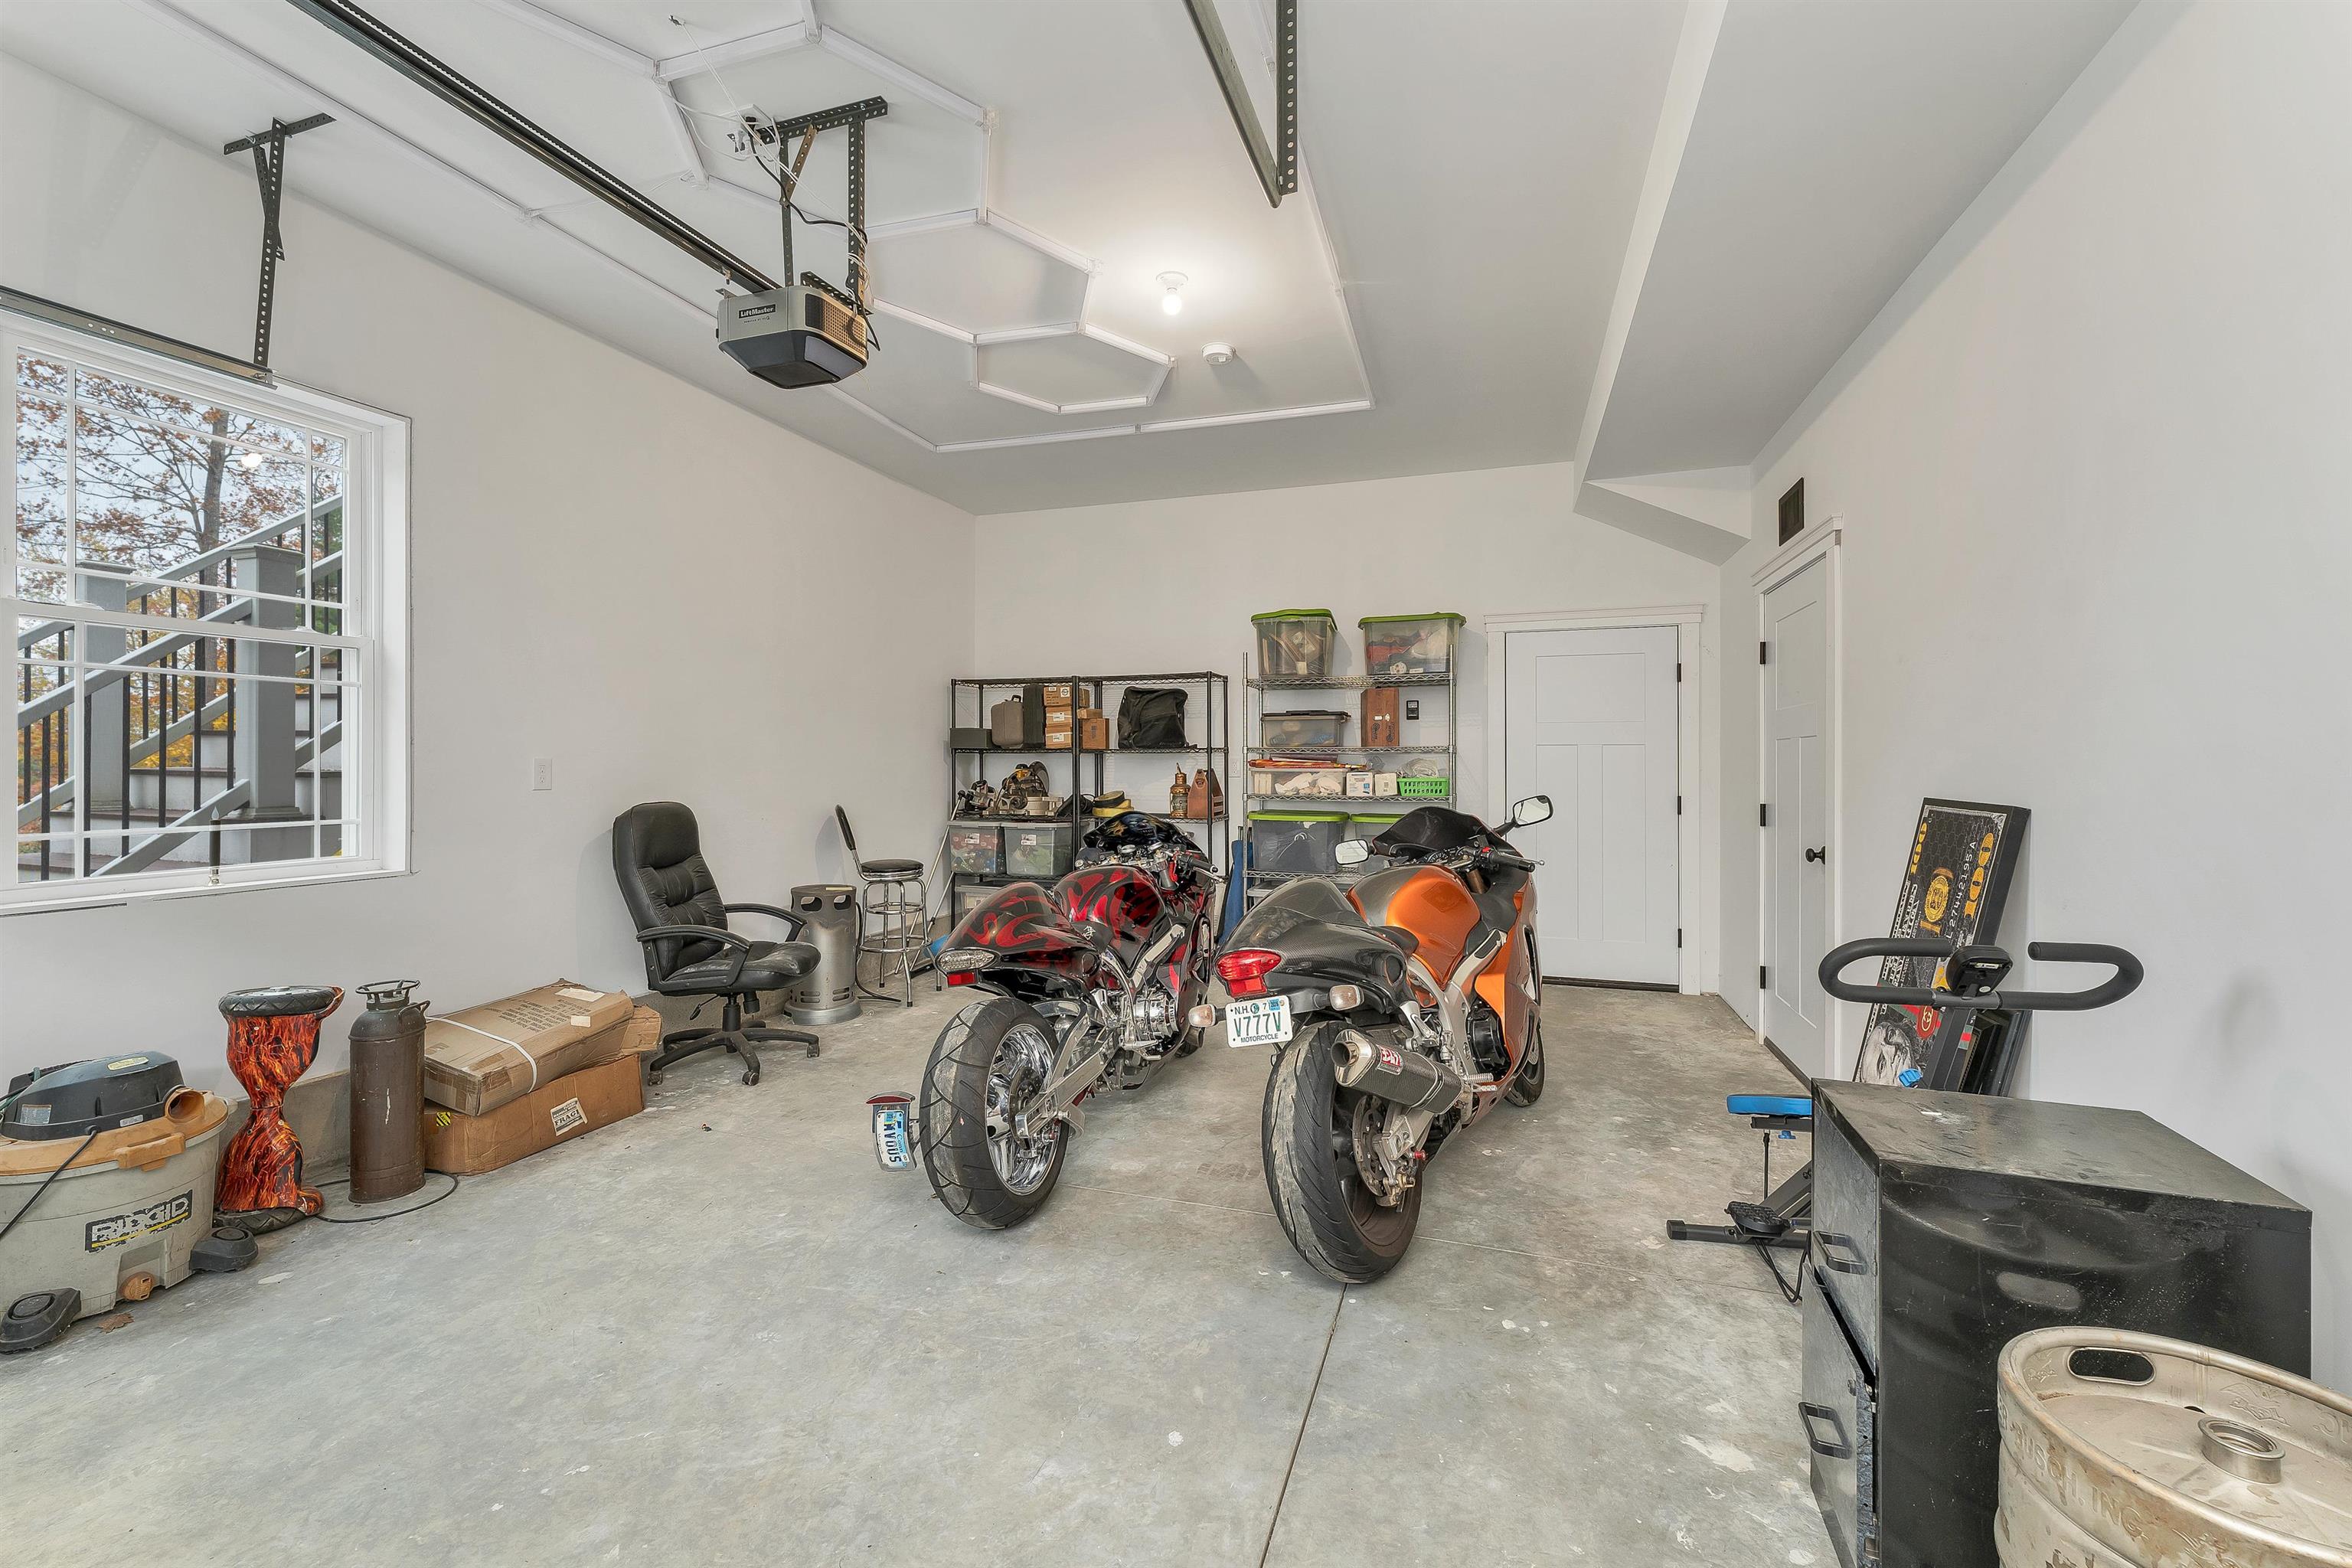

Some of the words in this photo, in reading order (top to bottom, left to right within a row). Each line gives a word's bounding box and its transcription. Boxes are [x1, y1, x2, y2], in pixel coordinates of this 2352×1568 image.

[740, 307, 774, 317] LiftMaster
[1952, 854, 1973, 927] 27442195
[1963, 832, 1994, 920] 100
[1233, 1011, 1282, 1037] V777V
[1240, 1033, 1279, 1043] MOTORCYCLE
[92, 1197, 189, 1242] RIDGID
